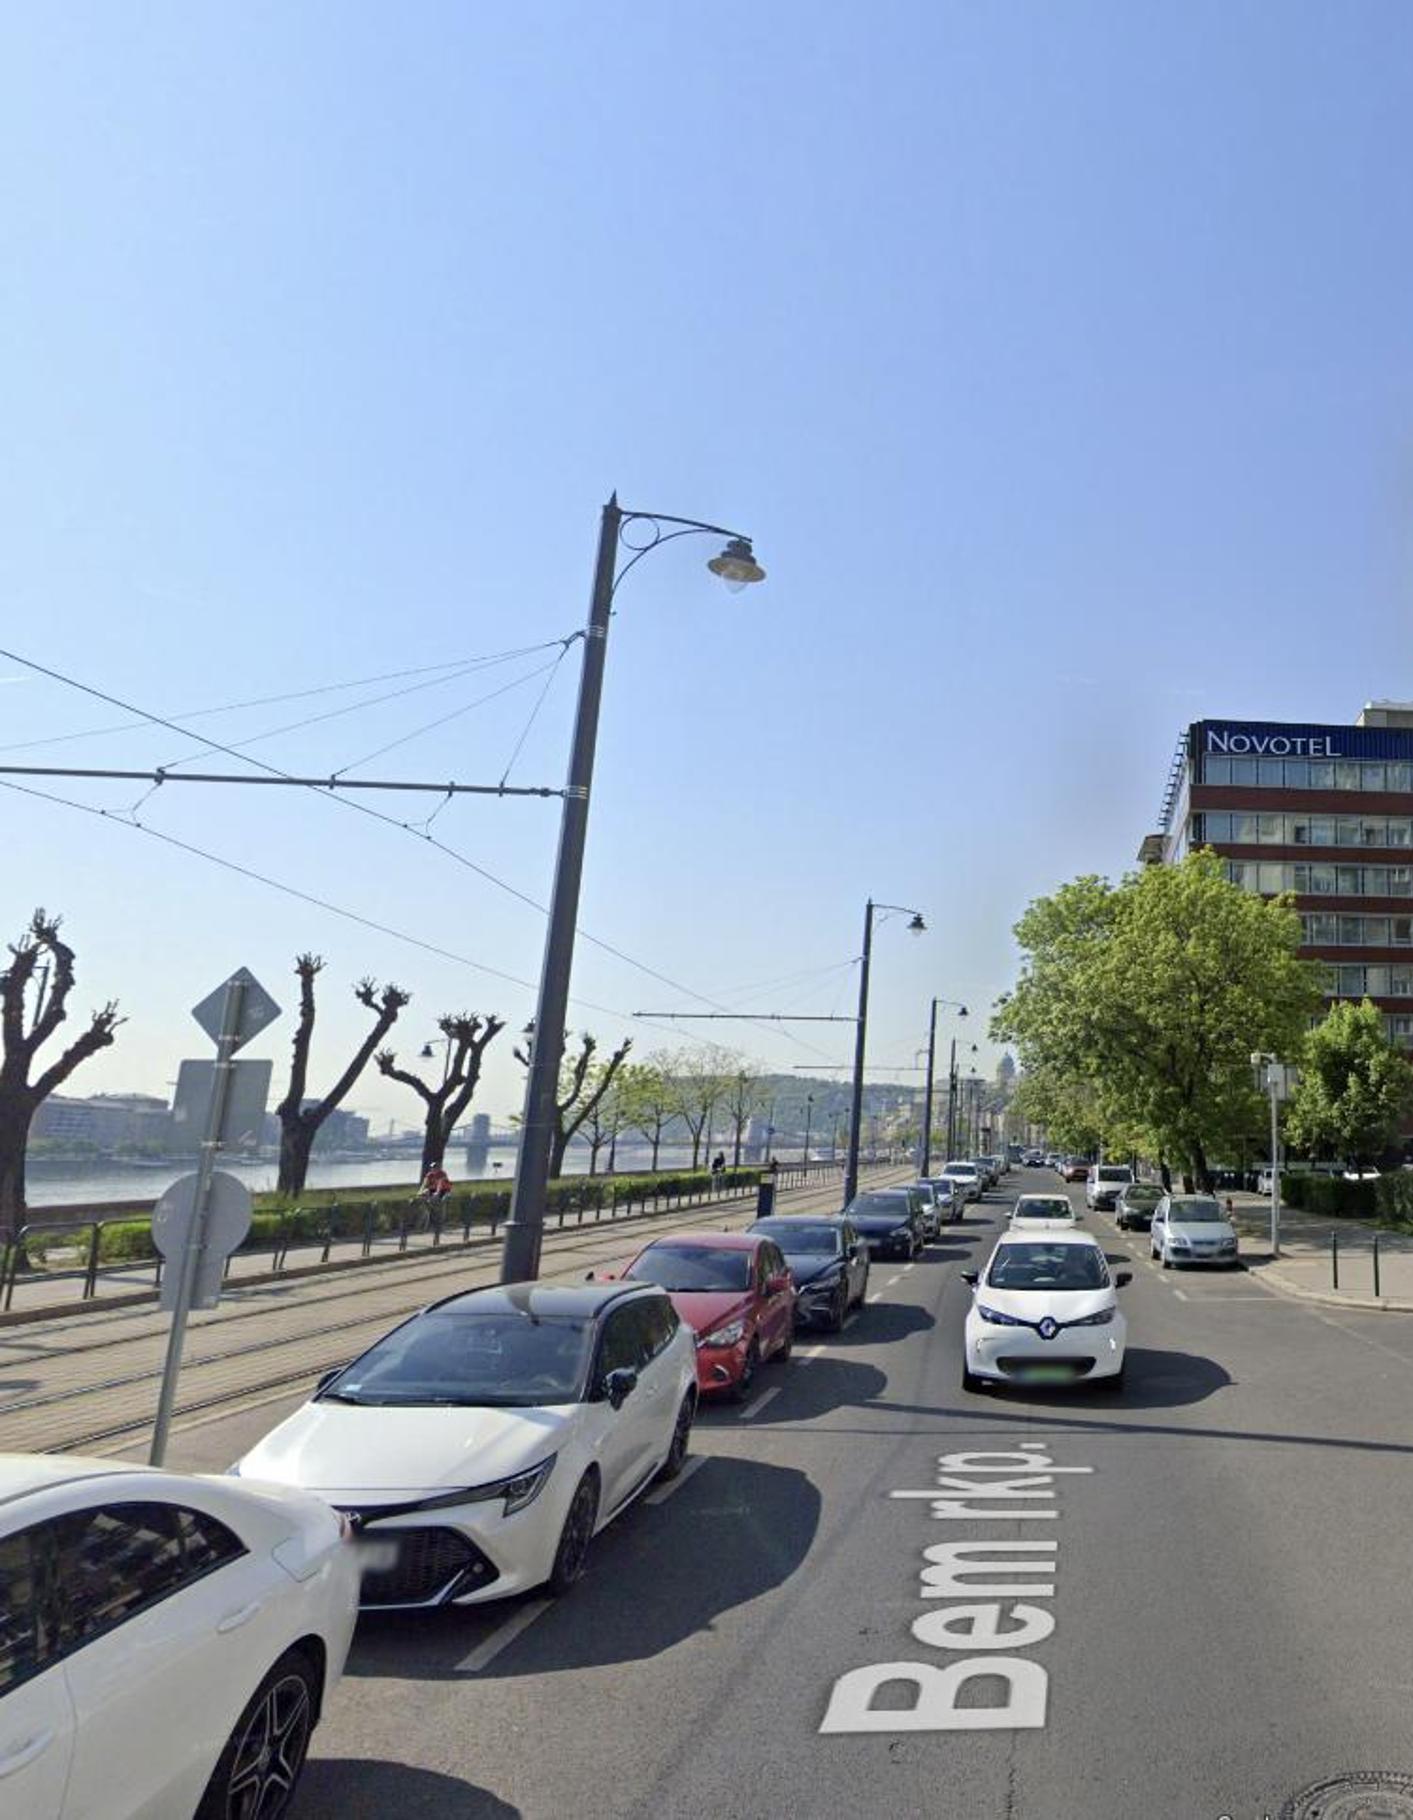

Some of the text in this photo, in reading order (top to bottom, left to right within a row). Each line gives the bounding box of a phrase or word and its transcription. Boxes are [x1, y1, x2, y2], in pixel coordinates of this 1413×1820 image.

[1207, 730, 1342, 757] NOVOTEL
[818, 1443, 1094, 1734] Bem rkp.
